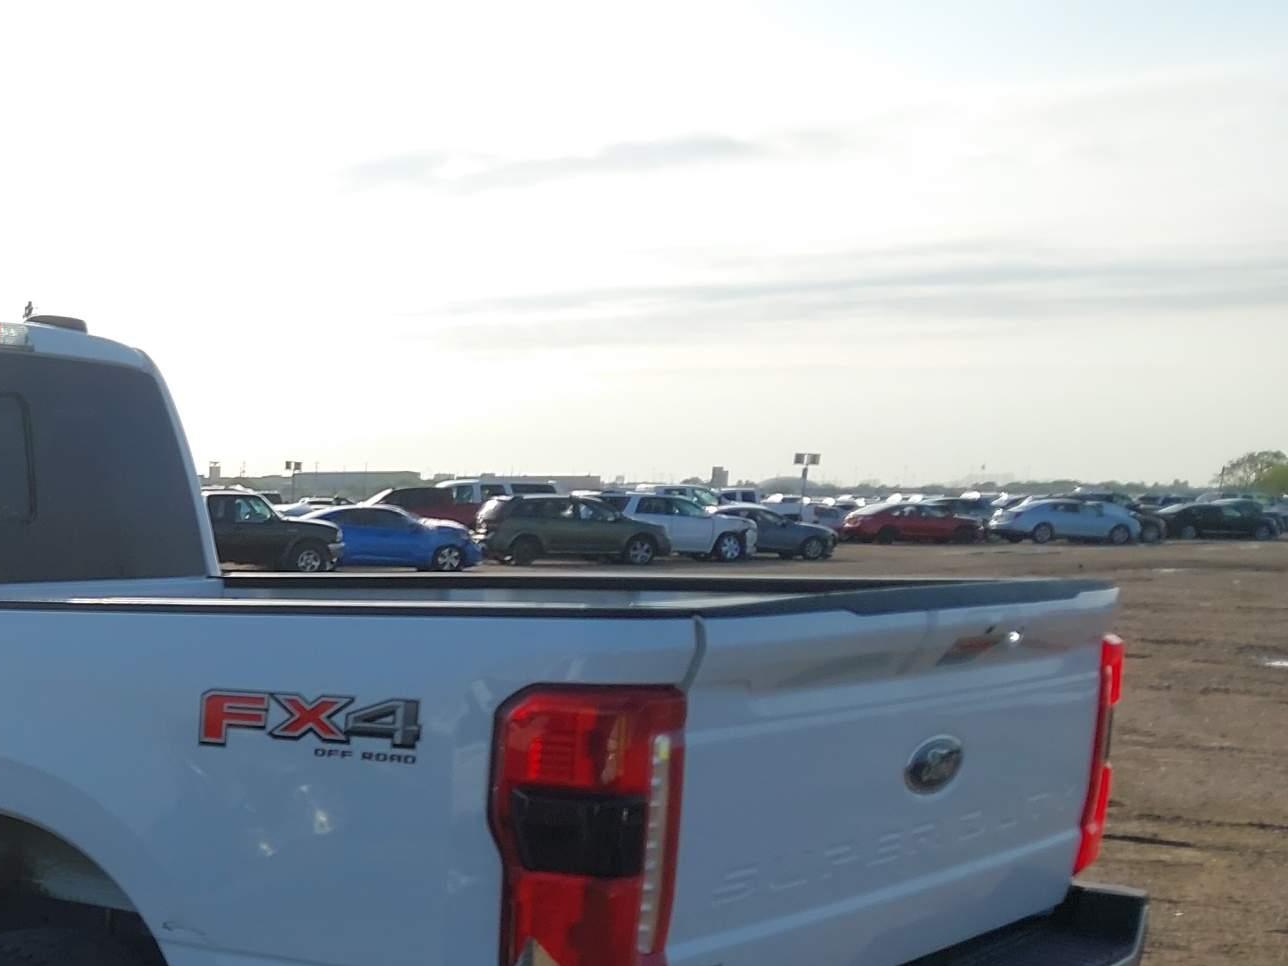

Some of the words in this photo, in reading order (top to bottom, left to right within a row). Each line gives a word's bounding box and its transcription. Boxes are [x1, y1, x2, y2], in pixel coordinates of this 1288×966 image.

[198, 689, 422, 749] FX4
[314, 748, 354, 760] OFF
[361, 752, 417, 766] ROAD
